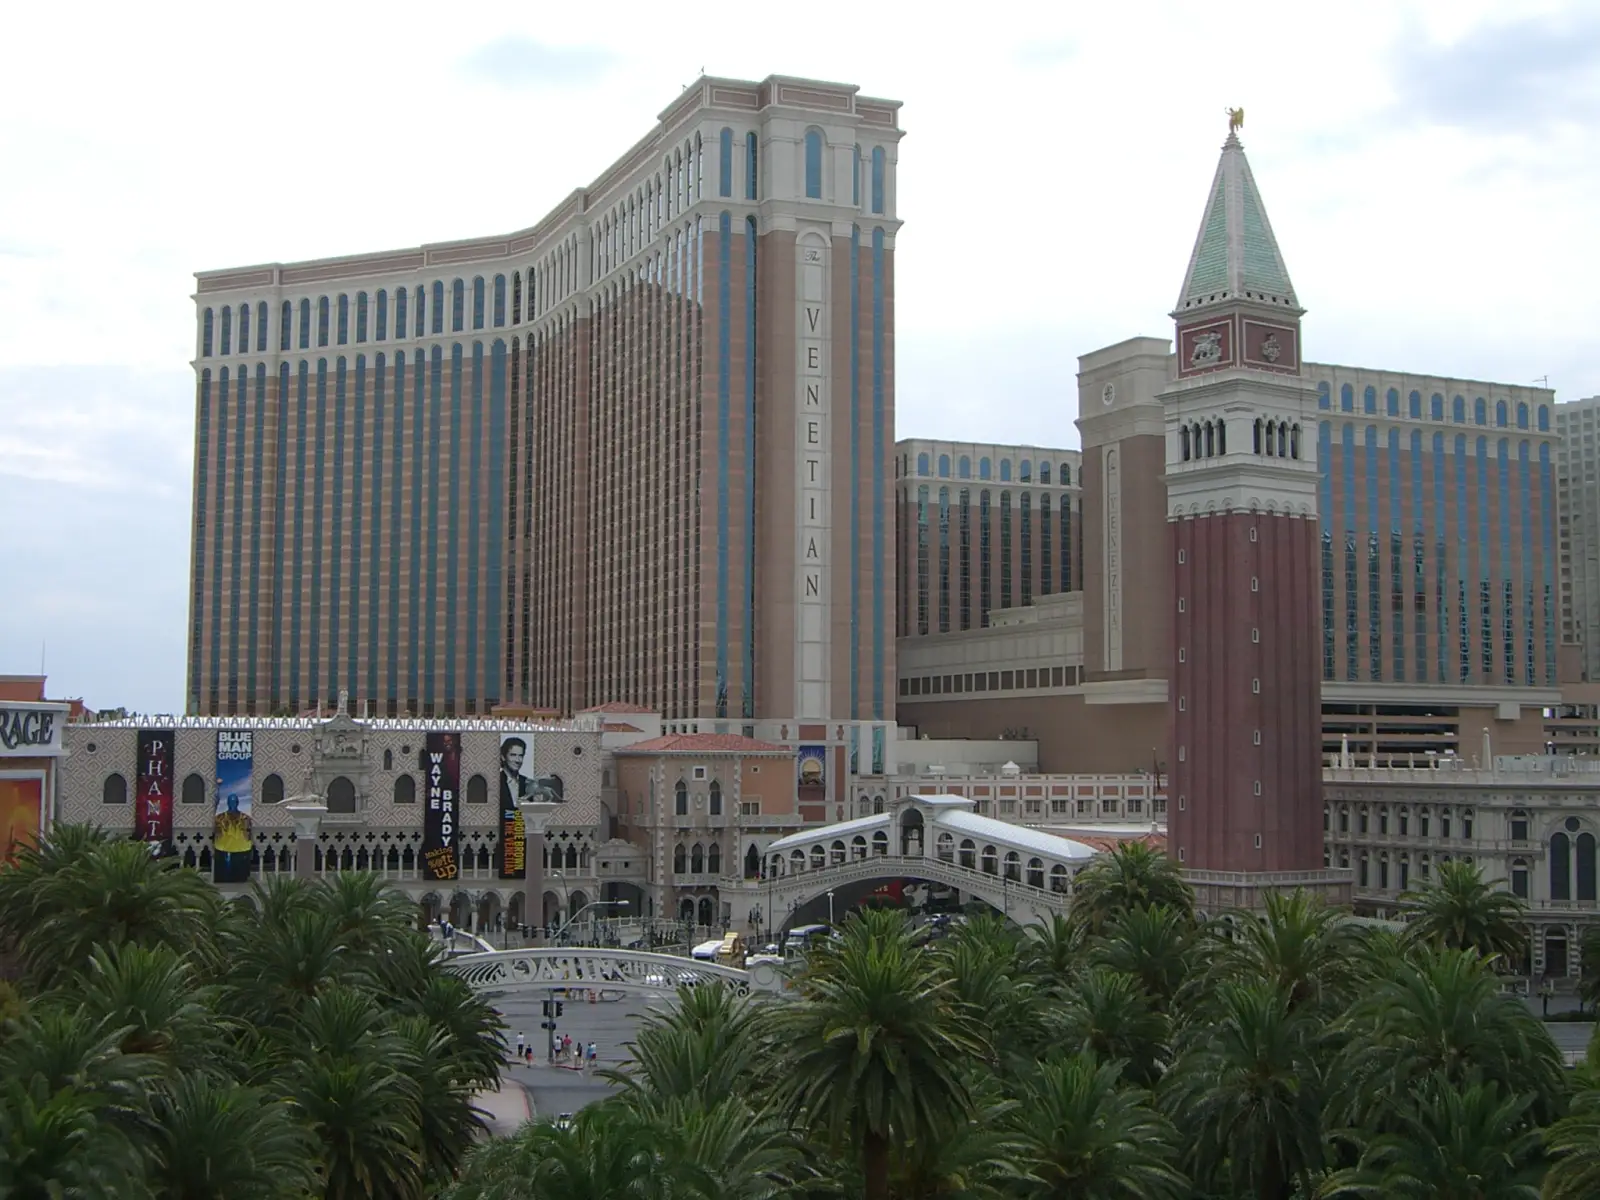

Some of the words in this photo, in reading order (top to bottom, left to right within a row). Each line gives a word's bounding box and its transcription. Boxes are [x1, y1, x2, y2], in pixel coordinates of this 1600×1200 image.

[805, 307, 820, 597] VENETIAN
[218, 731, 252, 742] BLUE
[218, 742, 252, 753] MAN
[218, 752, 252, 761] GROUP
[430, 753, 443, 809] WAYNE
[442, 790, 452, 846] BRADY
